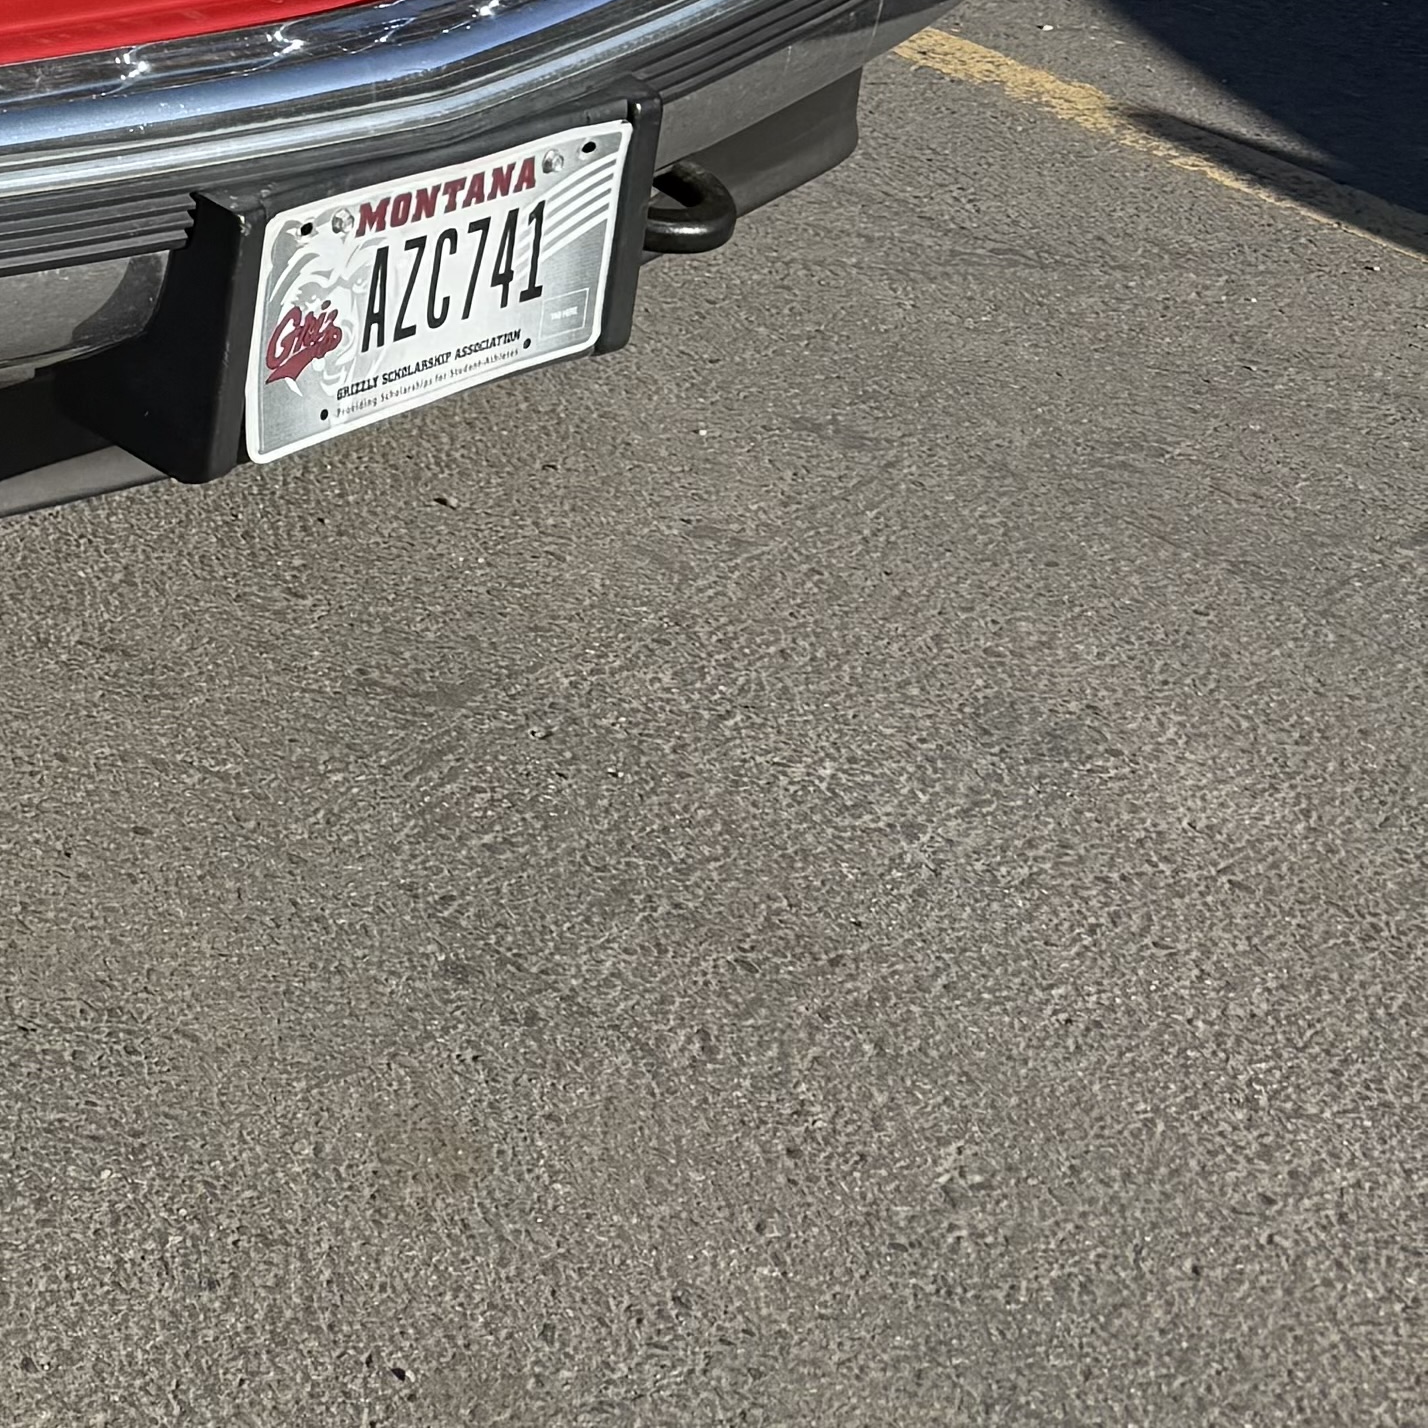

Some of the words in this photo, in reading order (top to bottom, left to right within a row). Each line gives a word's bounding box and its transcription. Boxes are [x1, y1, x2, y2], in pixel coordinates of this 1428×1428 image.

[355, 157, 537, 237] MONTANA
[360, 200, 547, 353] AZC741
[336, 375, 380, 401] GRIZZLY
[381, 351, 452, 385] SCHOLARSHIP
[454, 328, 522, 361] ASSOCIATION
